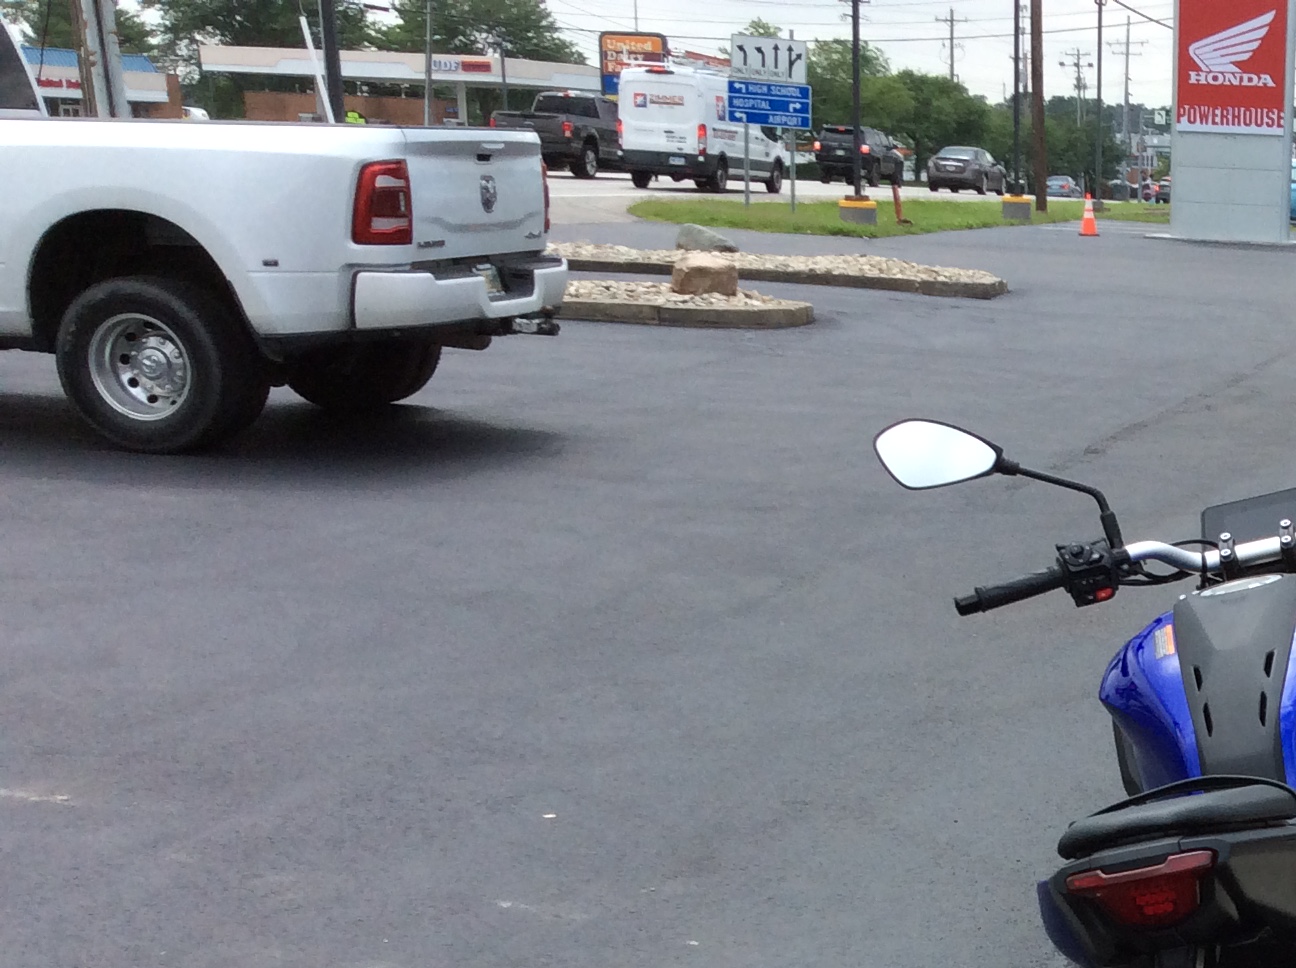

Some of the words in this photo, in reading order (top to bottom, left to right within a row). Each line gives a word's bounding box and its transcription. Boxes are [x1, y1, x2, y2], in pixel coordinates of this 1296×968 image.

[606, 39, 652, 51] United
[1188, 71, 1276, 87] HONDA
[748, 83, 768, 94] HIGH
[770, 85, 802, 97] SCHOOL
[732, 97, 771, 110] HOSPITAL
[768, 114, 802, 126] AIRPORT
[1176, 104, 1284, 128] POWERHOUSE
